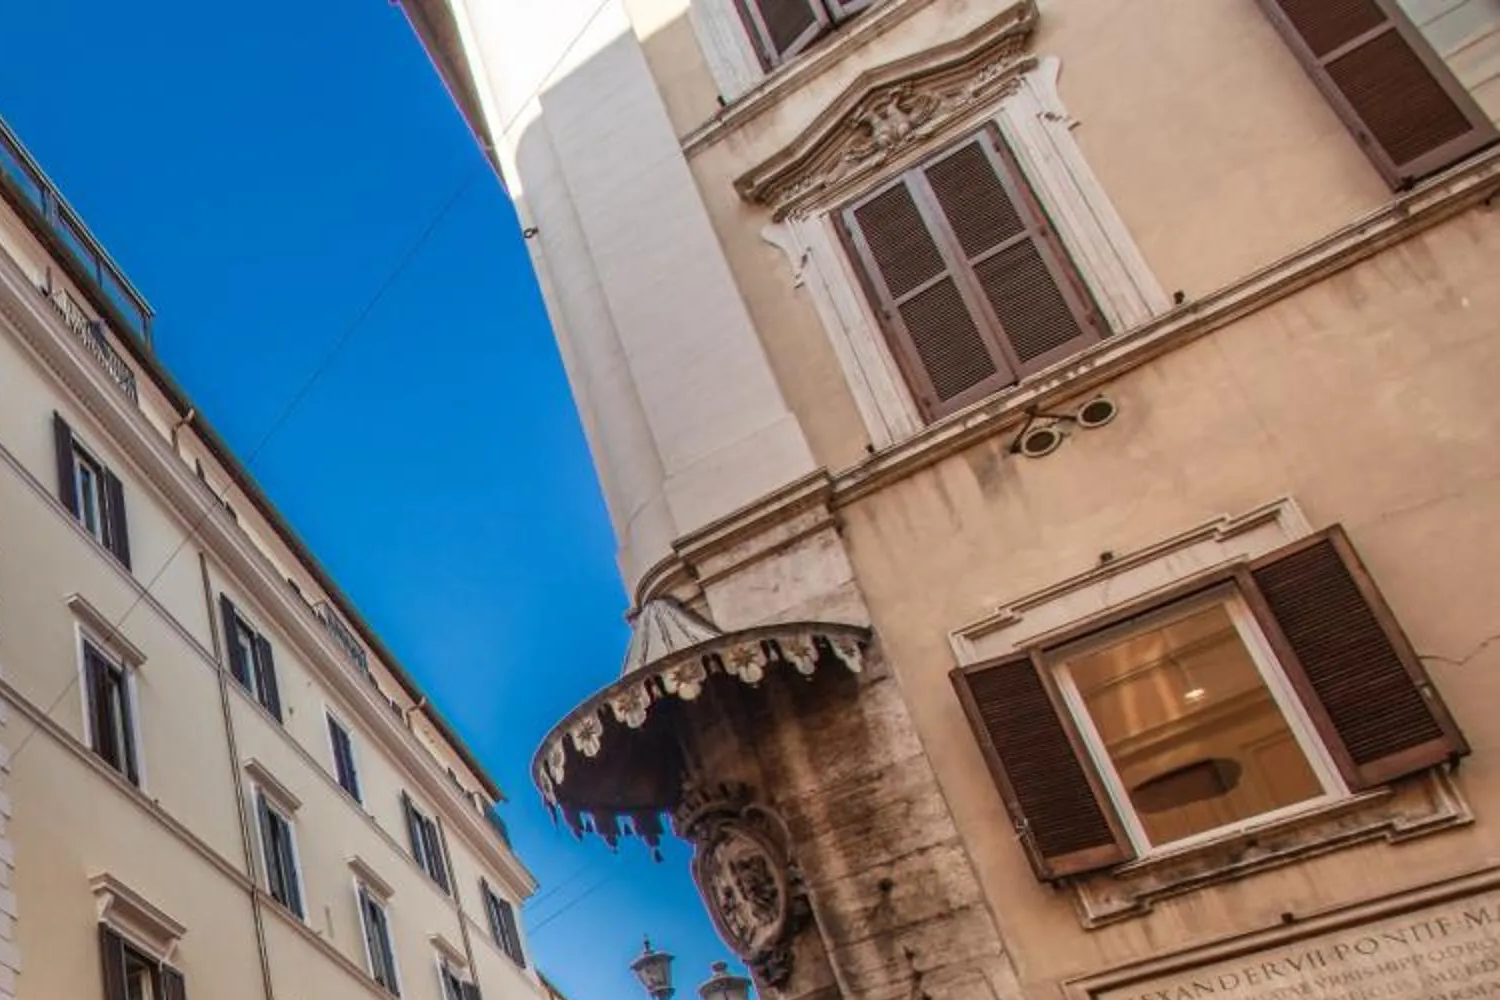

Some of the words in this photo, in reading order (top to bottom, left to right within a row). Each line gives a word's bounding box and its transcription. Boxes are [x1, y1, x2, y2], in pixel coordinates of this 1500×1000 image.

[1284, 949, 1327, 973] VII
[1333, 916, 1452, 961] PONTIF
[1463, 904, 1500, 929] M
